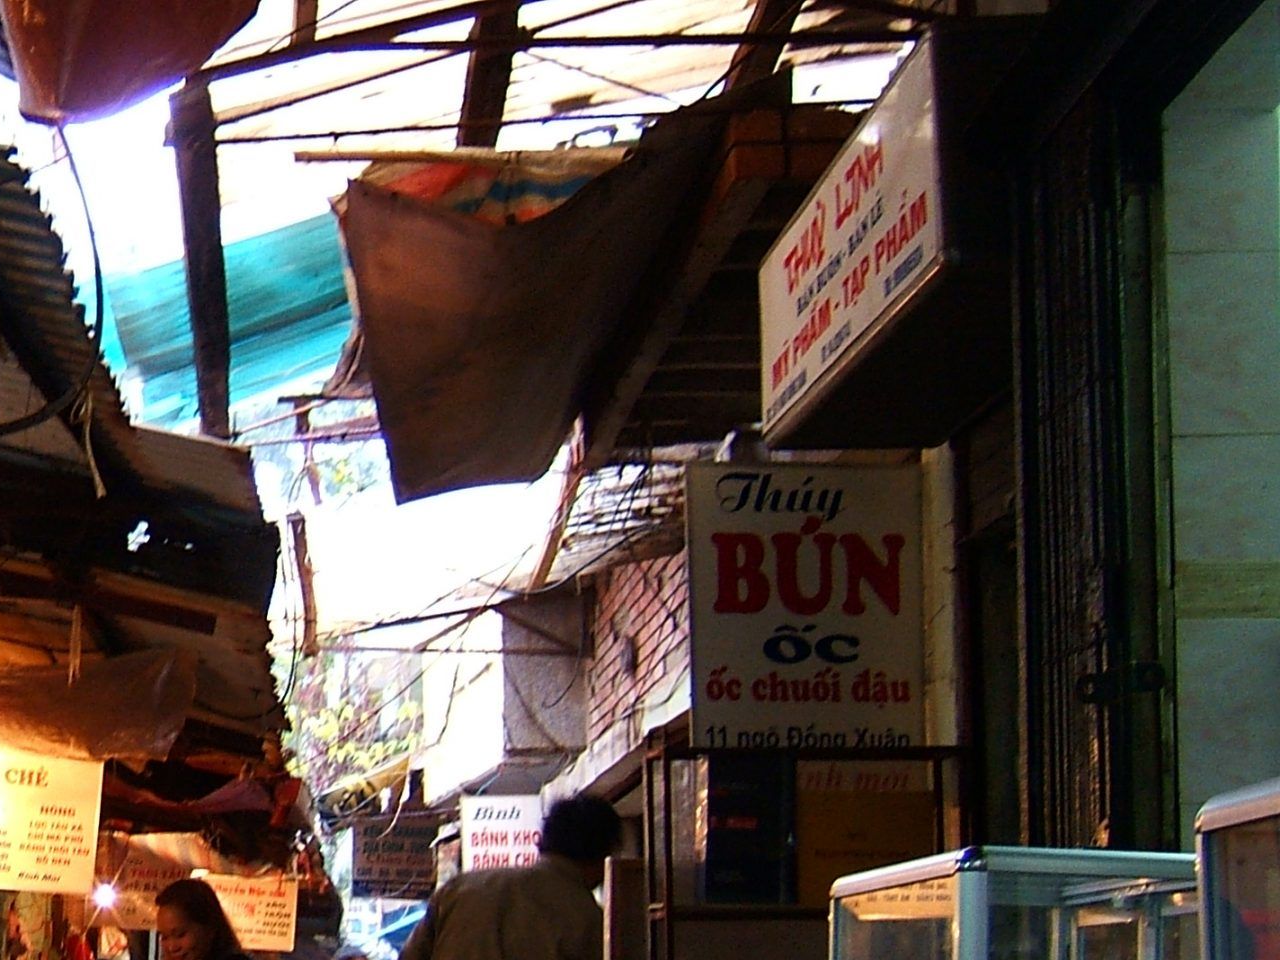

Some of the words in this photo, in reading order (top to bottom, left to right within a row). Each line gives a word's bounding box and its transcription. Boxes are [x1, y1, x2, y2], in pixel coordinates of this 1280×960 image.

[842, 255, 869, 309] TẠP
[875, 188, 928, 275] PHẨM
[716, 471, 844, 521] Thúy
[711, 516, 905, 617] BÚN
[706, 667, 741, 702] ốc
[751, 667, 841, 703] chuối
[851, 669, 911, 709] đậu
[471, 826, 509, 848] BÁNH
